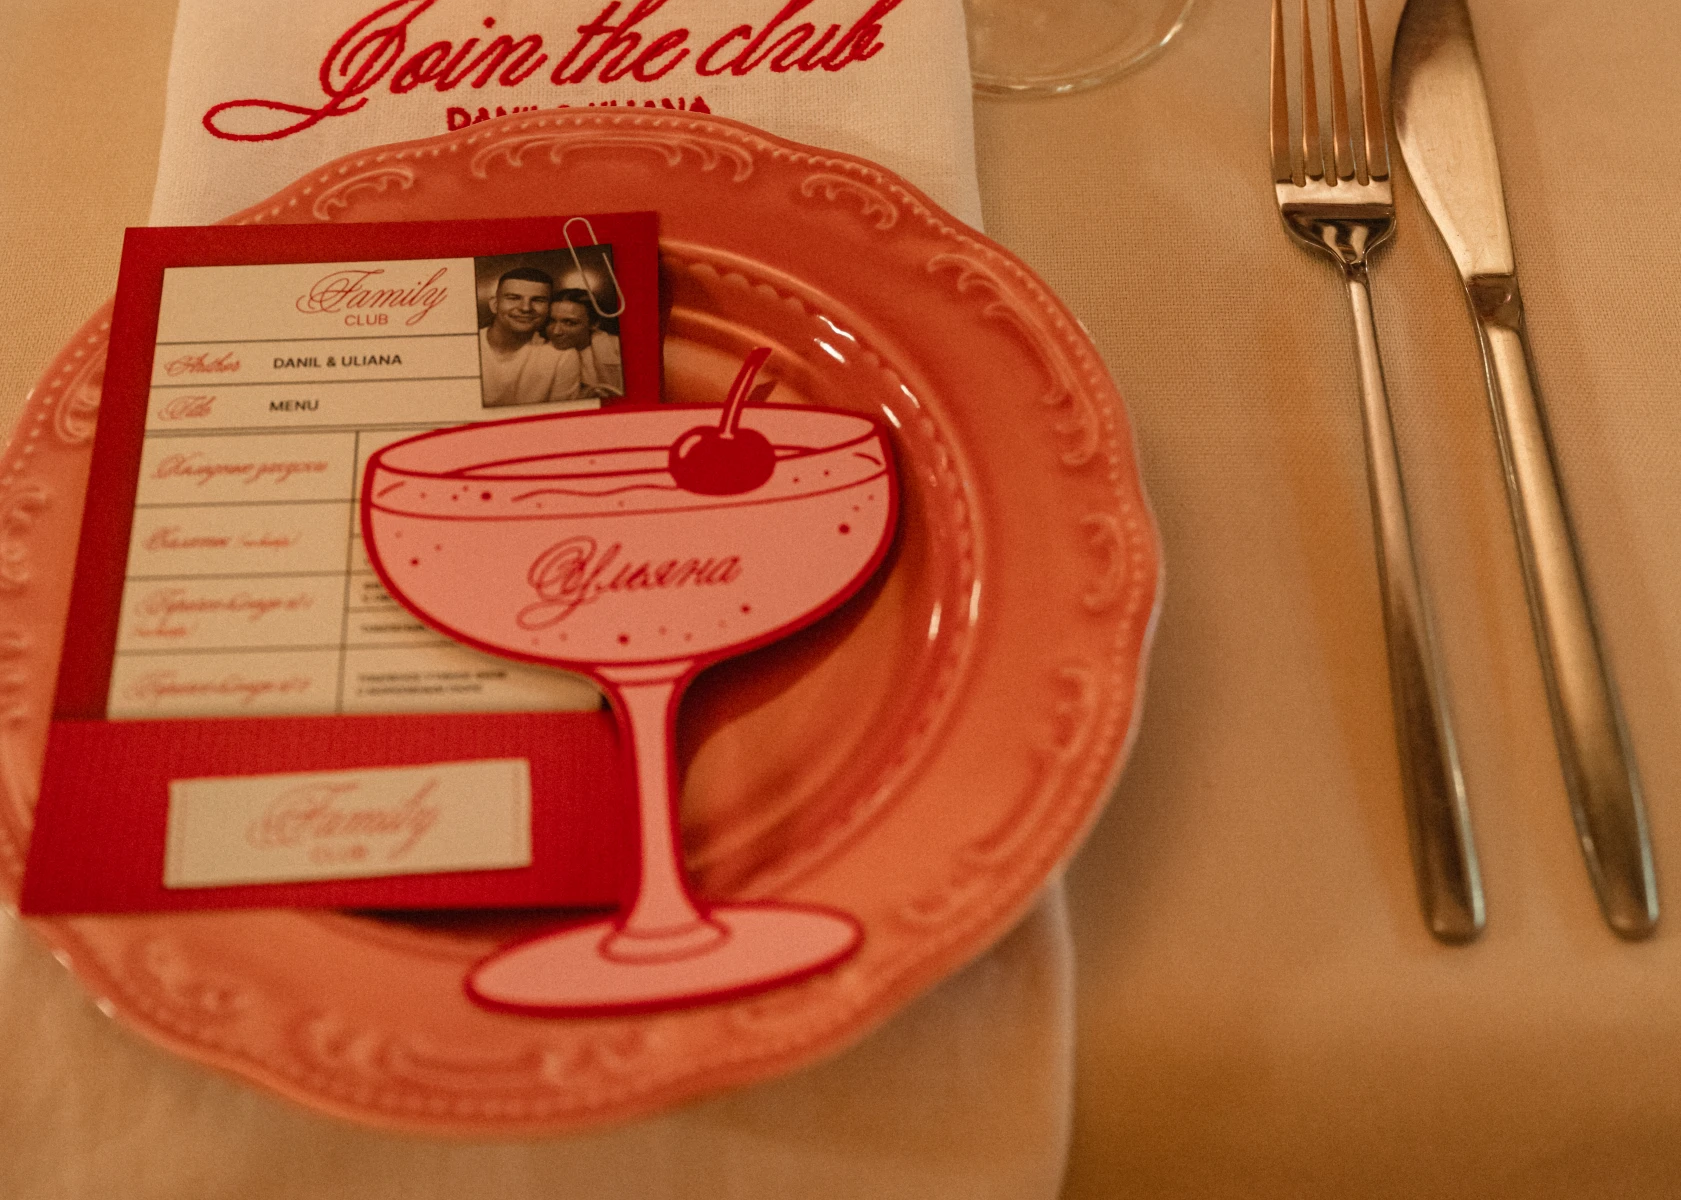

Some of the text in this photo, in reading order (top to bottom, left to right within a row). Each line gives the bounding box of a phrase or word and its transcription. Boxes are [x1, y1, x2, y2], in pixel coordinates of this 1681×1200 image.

[296, 267, 448, 326] Family
[344, 314, 388, 326] CLUB
[273, 354, 402, 369] DANIL & ULIANA
[269, 400, 319, 412] MENU
[516, 534, 742, 631] Ульяна
